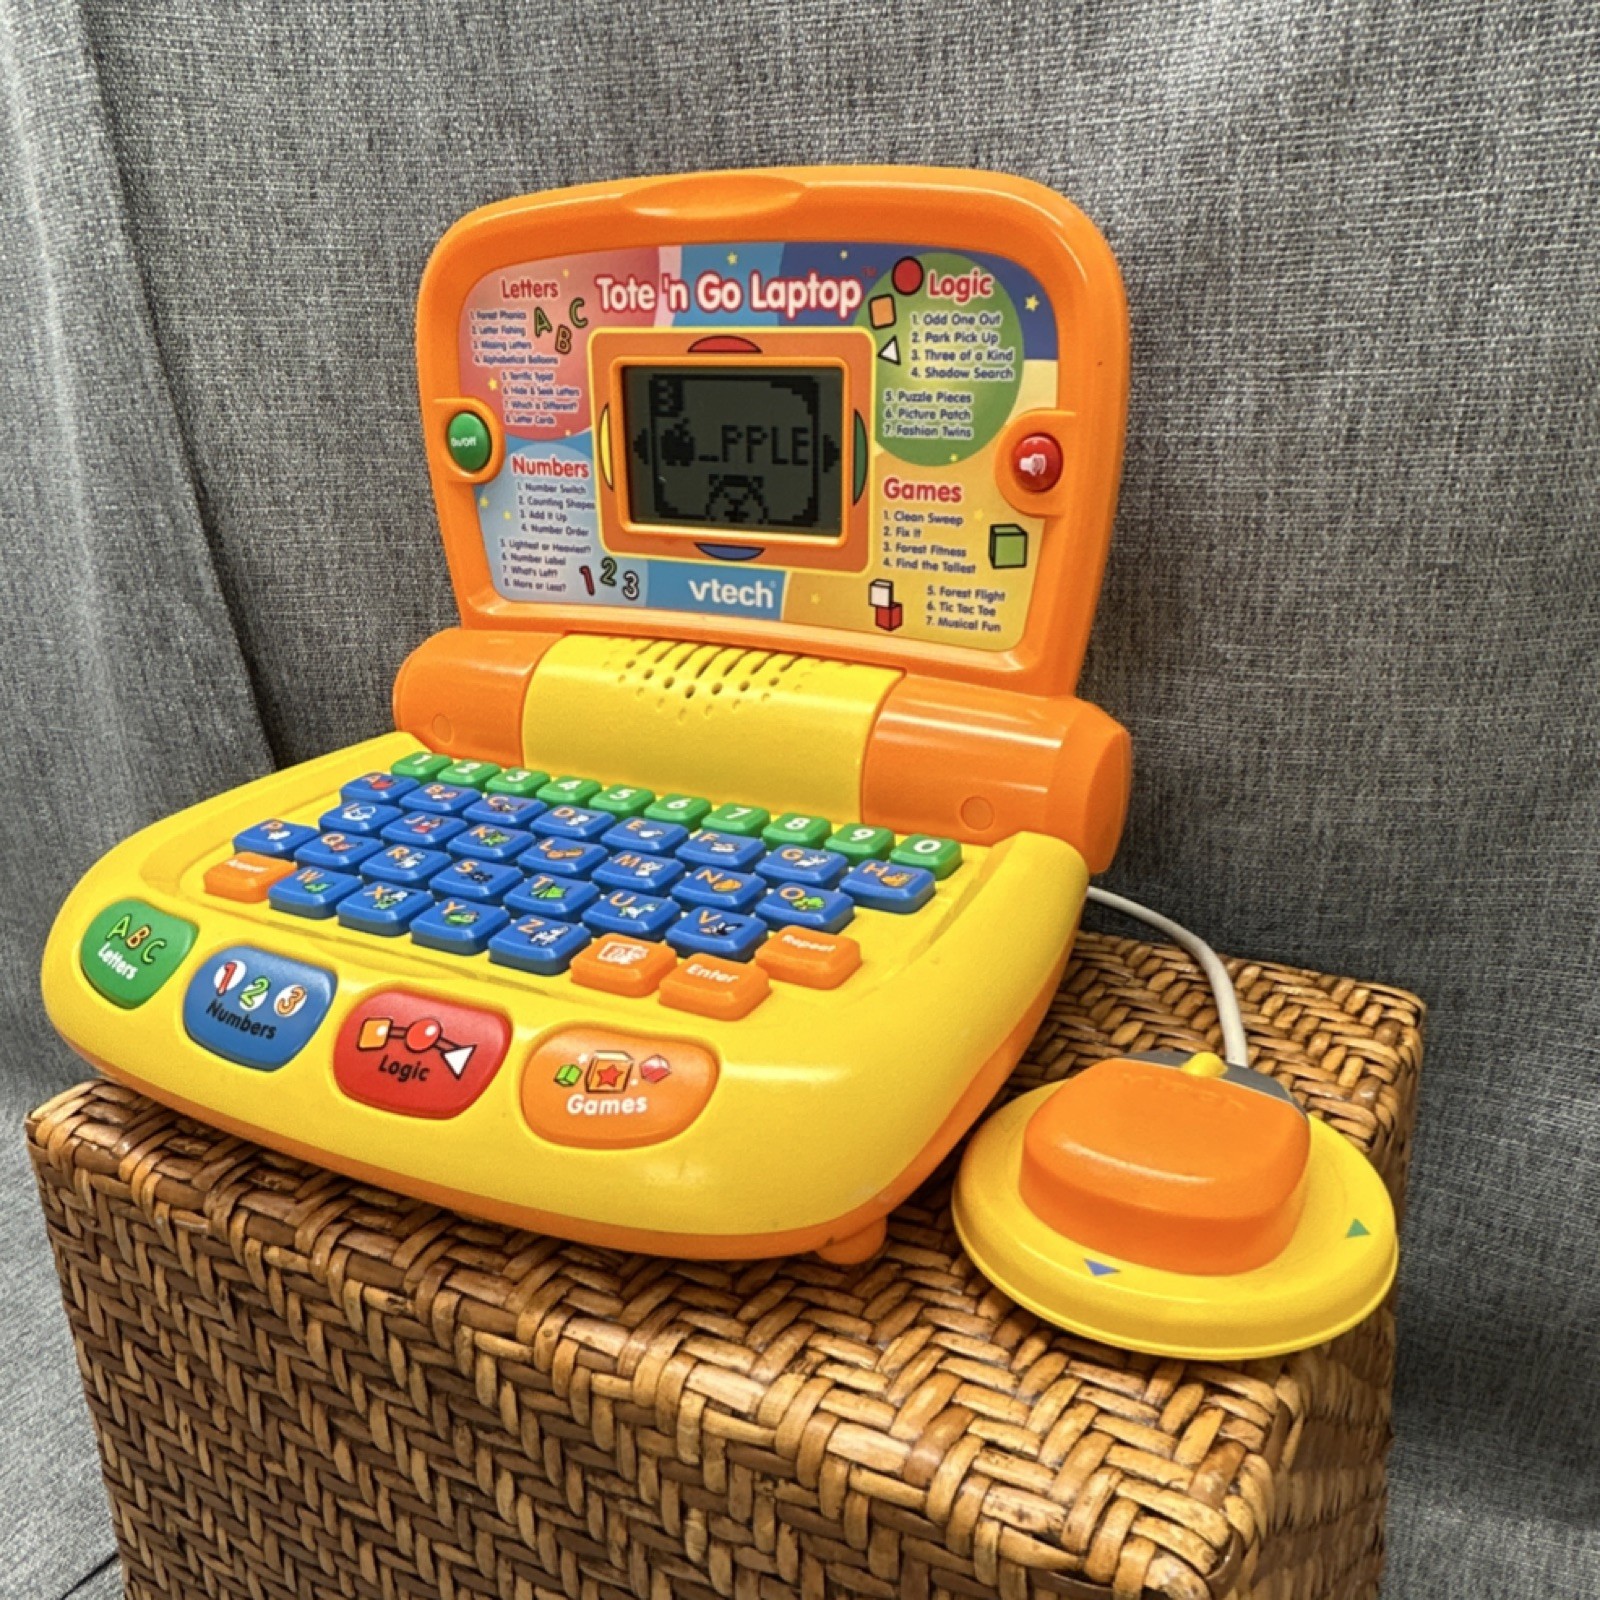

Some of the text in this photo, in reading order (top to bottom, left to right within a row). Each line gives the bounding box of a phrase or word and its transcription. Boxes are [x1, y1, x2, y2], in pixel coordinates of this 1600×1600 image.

[502, 279, 559, 298] Letters
[929, 270, 993, 303] Logic
[596, 277, 656, 311] Tote
[697, 270, 741, 313] Go
[751, 270, 862, 320] Laptop
[924, 313, 947, 324] Odd
[951, 314, 975, 325] One
[980, 314, 1001, 324] Out
[535, 298, 588, 354] A B C
[925, 333, 949, 342] Park
[954, 333, 977, 342] Pick
[982, 334, 998, 345] Up
[925, 350, 955, 360] Three
[960, 350, 972, 360] of
[975, 352, 982, 360] a
[987, 349, 1013, 360] Kind
[925, 368, 969, 378] Shadow
[974, 368, 1013, 378] Search
[899, 391, 932, 402] Puzzle
[937, 392, 971, 403] Pieces
[899, 408, 936, 418] Picture
[941, 409, 970, 419] Patch
[897, 426, 938, 436] Fashion
[942, 426, 971, 437] Twins
[512, 457, 589, 478] Numbers
[526, 483, 557, 492] Number
[560, 485, 586, 494] Switch
[884, 478, 961, 502] Games
[527, 497, 563, 510] Counting
[529, 511, 545, 520] Add
[556, 513, 567, 522] Up
[894, 512, 924, 522] Clean
[928, 513, 963, 526] Sweep
[531, 525, 563, 534] Number
[566, 526, 589, 536] Order
[896, 528, 910, 537] Fix
[896, 543, 927, 554] Forest
[931, 545, 966, 557] Fitness
[896, 559, 917, 569] Find
[922, 560, 938, 570] the
[943, 562, 975, 573] Tallest
[579, 557, 639, 600] 1 2 3
[688, 579, 773, 609] vtech
[940, 586, 971, 598] Forest
[975, 589, 1005, 603] Flight
[940, 602, 953, 612] Tic
[957, 603, 974, 614] Tac
[979, 605, 996, 616] Toe
[938, 618, 978, 630] Musical
[982, 620, 1001, 632] Fun
[455, 763, 482, 774] 2
[506, 770, 531, 782] 3
[558, 780, 582, 791] 4
[610, 788, 637, 800] 5
[667, 798, 691, 810] 6
[726, 807, 751, 820] 7
[784, 818, 810, 829] 8
[850, 828, 876, 842] 9
[914, 840, 941, 853] 0
[781, 848, 804, 860] G
[454, 861, 478, 873] S
[613, 855, 641, 867] M
[697, 870, 723, 884] N
[363, 885, 393, 899] X
[780, 888, 805, 899] O
[610, 893, 636, 906] U
[442, 901, 466, 914] Y
[518, 918, 545, 932] Z
[699, 911, 722, 929] V
[106, 914, 167, 964] A B C
[97, 943, 138, 979] Letters
[686, 963, 739, 983] Enter
[216, 961, 306, 1016] 1 2 3
[205, 1000, 277, 1040] Numbers
[377, 1055, 430, 1082] Logic
[567, 1094, 647, 1116] Games
